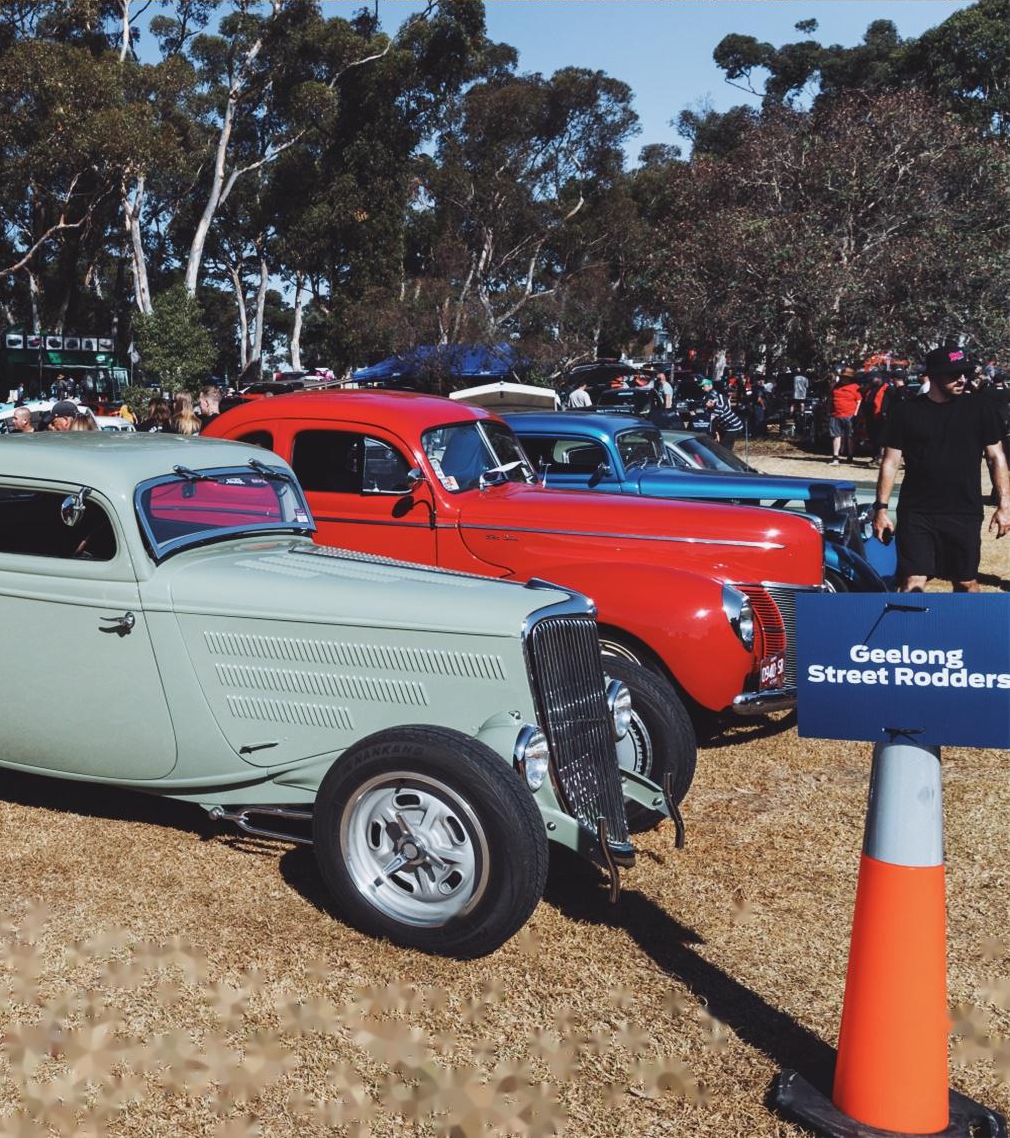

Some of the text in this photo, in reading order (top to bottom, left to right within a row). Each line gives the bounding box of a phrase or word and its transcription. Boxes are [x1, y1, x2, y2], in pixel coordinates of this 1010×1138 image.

[849, 644, 964, 669] Geelong
[808, 664, 1010, 689] Street Rodders
